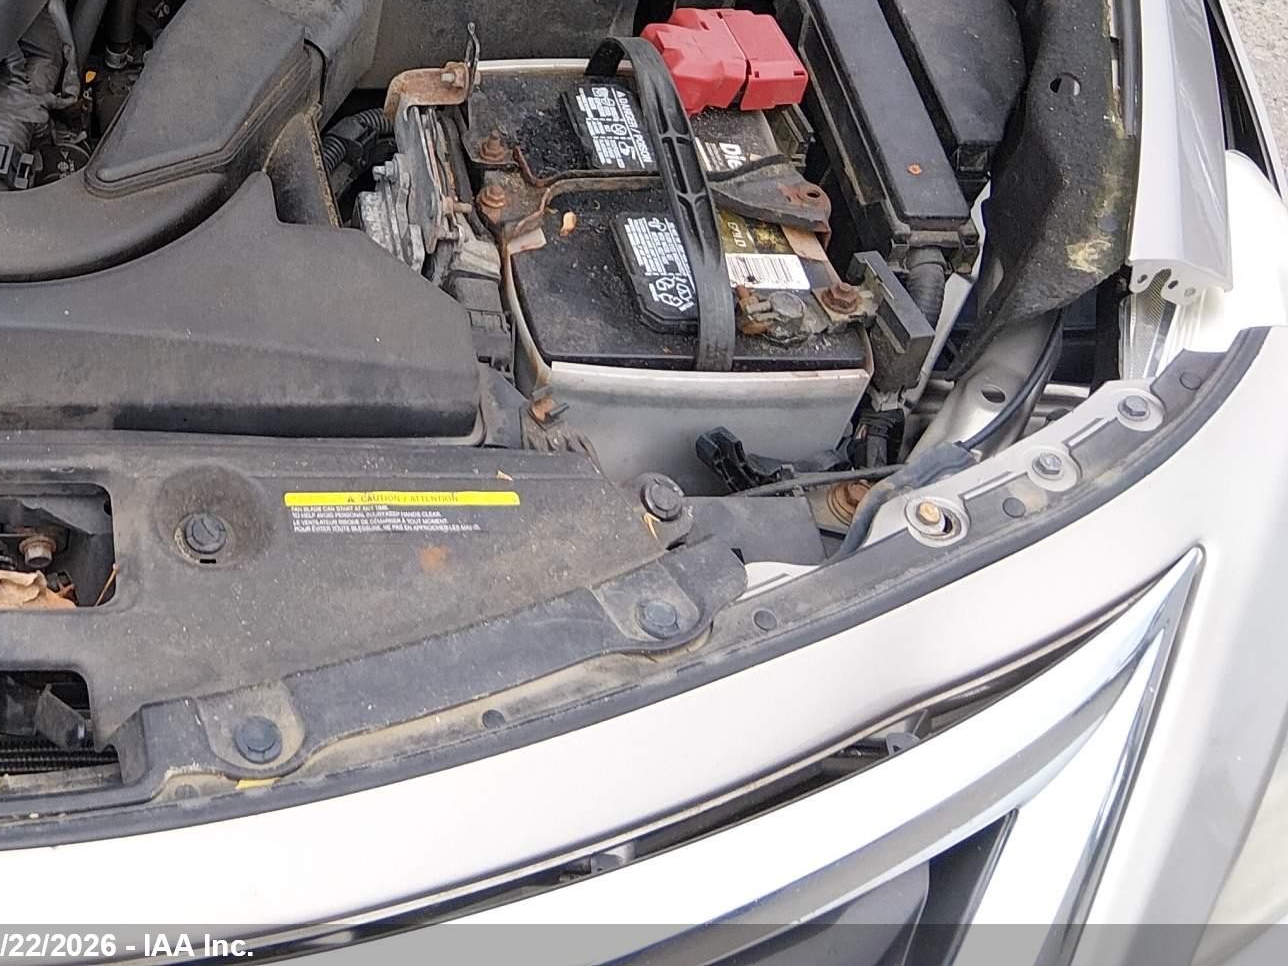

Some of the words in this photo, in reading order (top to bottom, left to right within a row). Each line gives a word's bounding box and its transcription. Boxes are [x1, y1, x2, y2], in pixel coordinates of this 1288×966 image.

[619, 98, 638, 128] DANGER
[633, 134, 652, 162] POISON
[728, 222, 746, 248] GOLD
[360, 493, 400, 502] CAUTION
[410, 494, 458, 502] ATTENTION
